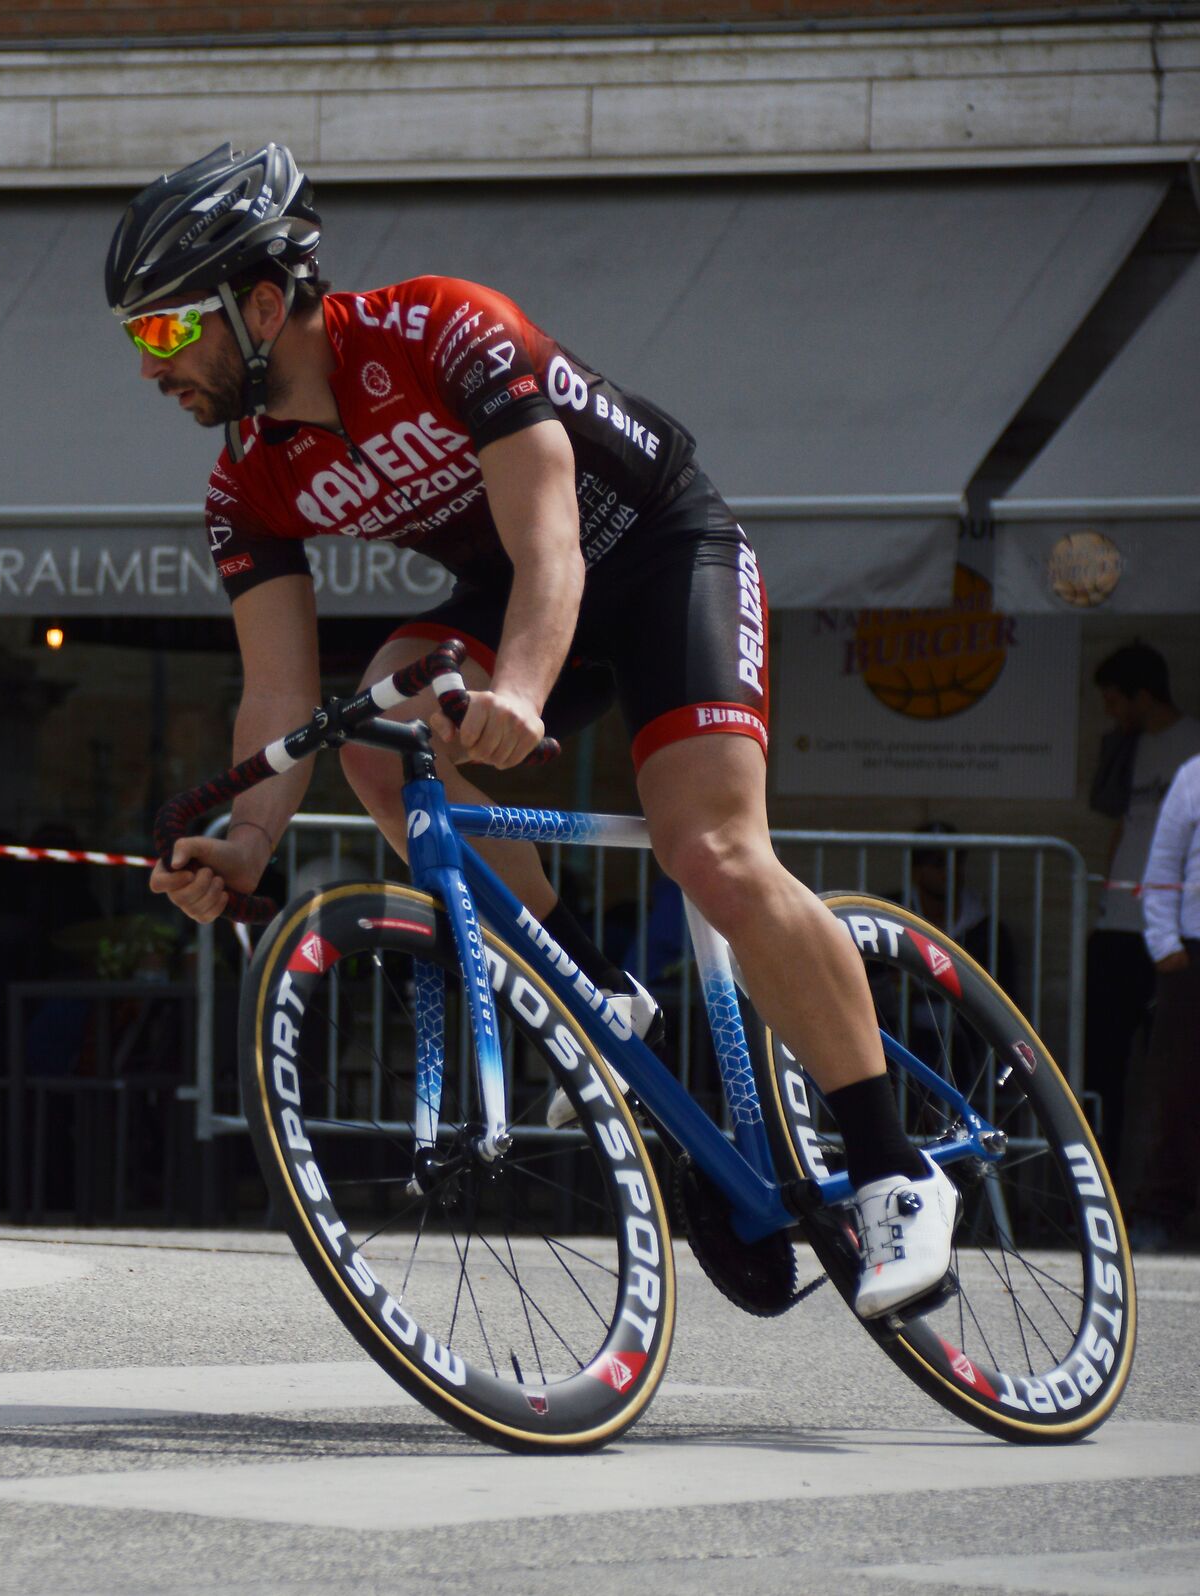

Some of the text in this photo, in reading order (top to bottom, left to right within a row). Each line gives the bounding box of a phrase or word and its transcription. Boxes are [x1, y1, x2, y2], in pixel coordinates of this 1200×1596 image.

[179, 187, 241, 250] SUPREME
[483, 379, 539, 415] BIOTEX
[296, 411, 471, 528] RAVENS
[586, 503, 635, 560] ATILDA
[217, 557, 251, 577] TEX
[305, 546, 458, 597] BURG
[842, 616, 1019, 675] BURGER
[456, 881, 494, 1037] FREE-COLOR
[999, 1143, 1124, 1414] MOSTSPORT
